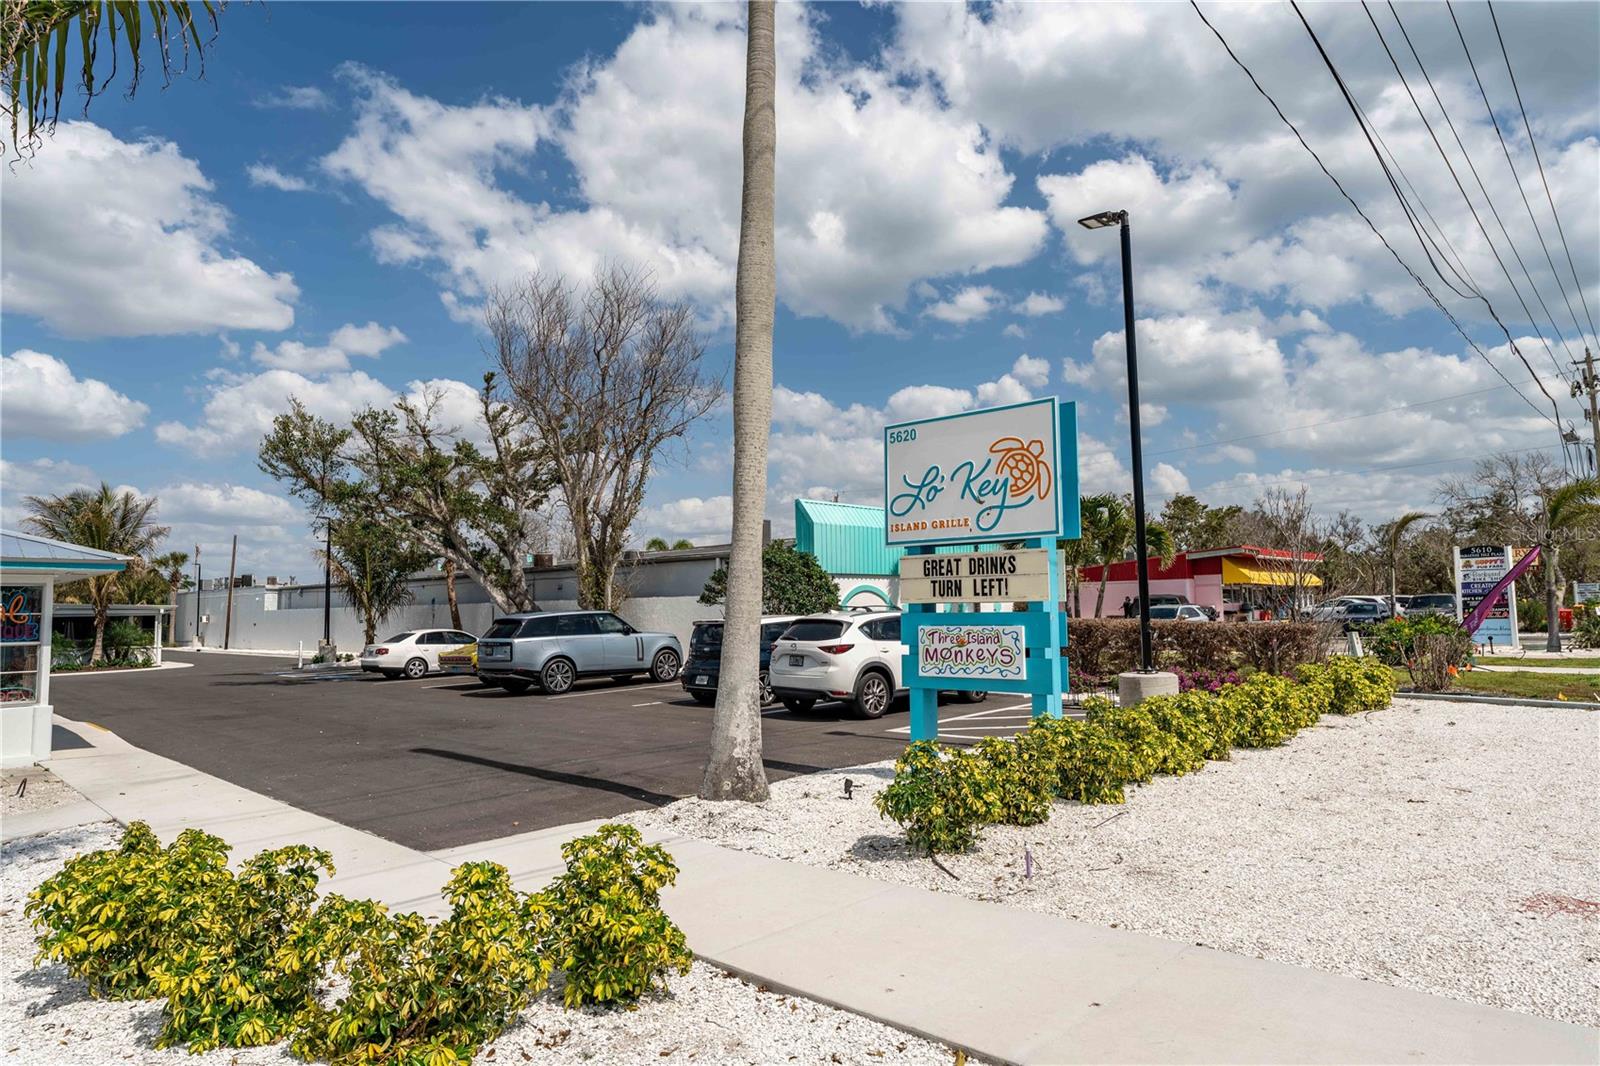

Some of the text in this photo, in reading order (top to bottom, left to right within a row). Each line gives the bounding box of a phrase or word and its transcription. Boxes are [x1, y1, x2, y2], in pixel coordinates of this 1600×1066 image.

[889, 428, 917, 444] 5620
[950, 458, 1034, 532] Key
[890, 517, 970, 533] ISLAND GRILLE
[1470, 546, 1492, 554] 5610
[923, 555, 1017, 577] GREAT DRINKS
[931, 578, 1009, 598] TURN LEFT!
[928, 630, 1000, 645] Three Island
